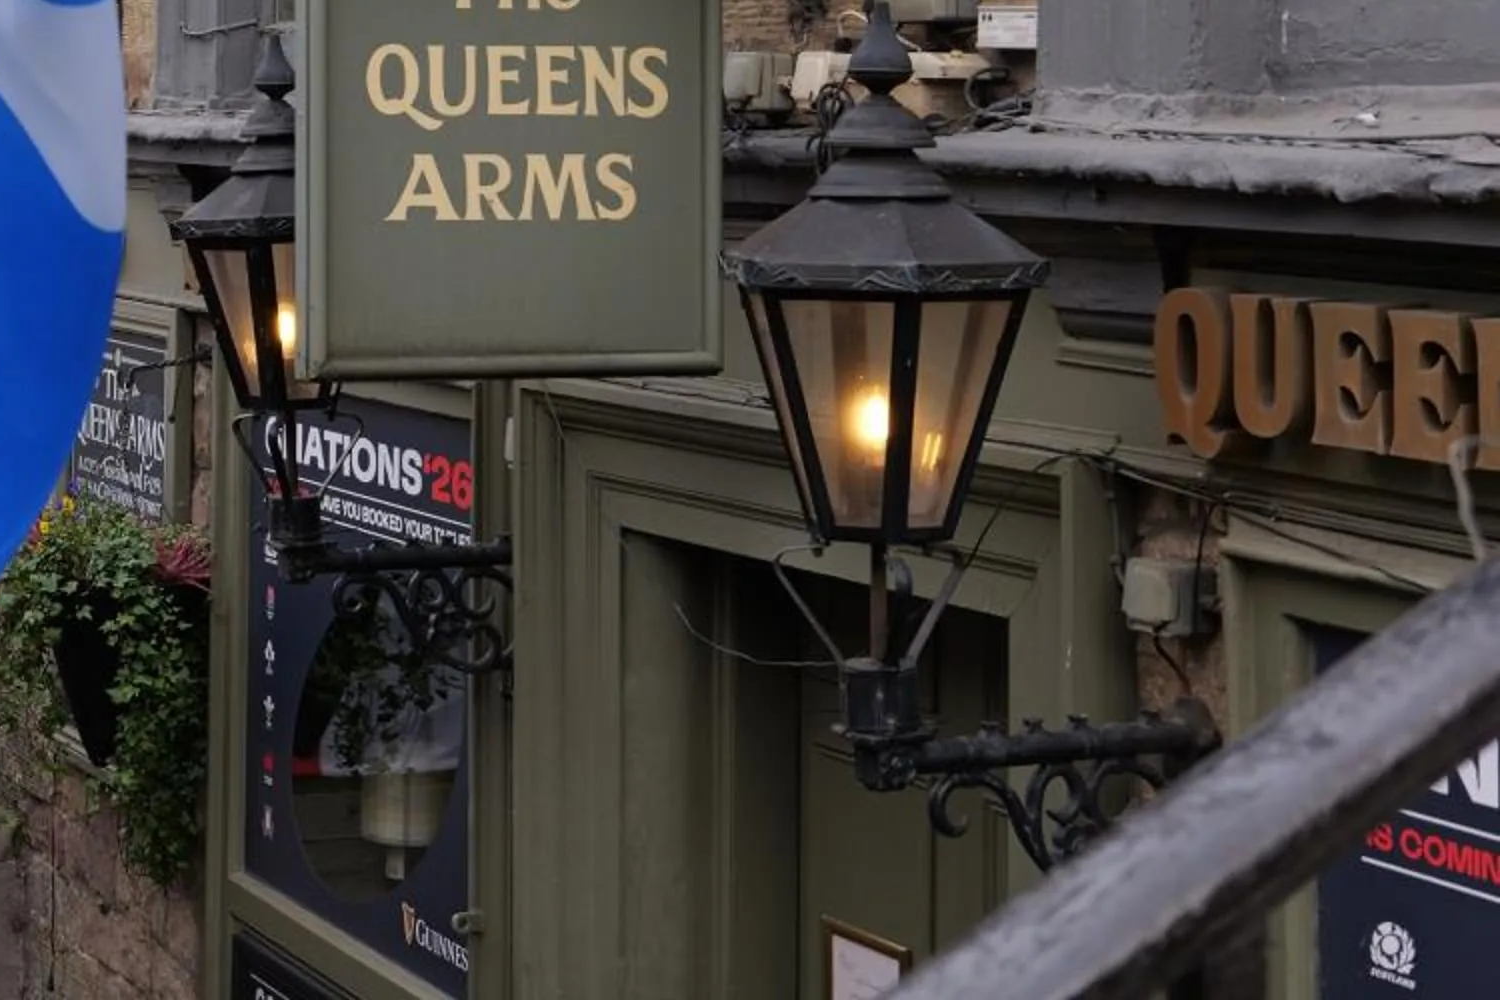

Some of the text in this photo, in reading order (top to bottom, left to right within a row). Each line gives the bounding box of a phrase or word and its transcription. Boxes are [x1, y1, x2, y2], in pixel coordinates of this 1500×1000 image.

[365, 43, 669, 131] QUEENS
[384, 153, 638, 222] ARMS
[320, 494, 341, 515] AVE
[342, 500, 361, 521] YOU
[362, 505, 403, 533] BOOKED
[404, 517, 433, 543] YOUR
[1399, 827, 1500, 887] COMIN
[415, 919, 469, 971] GUINNES
